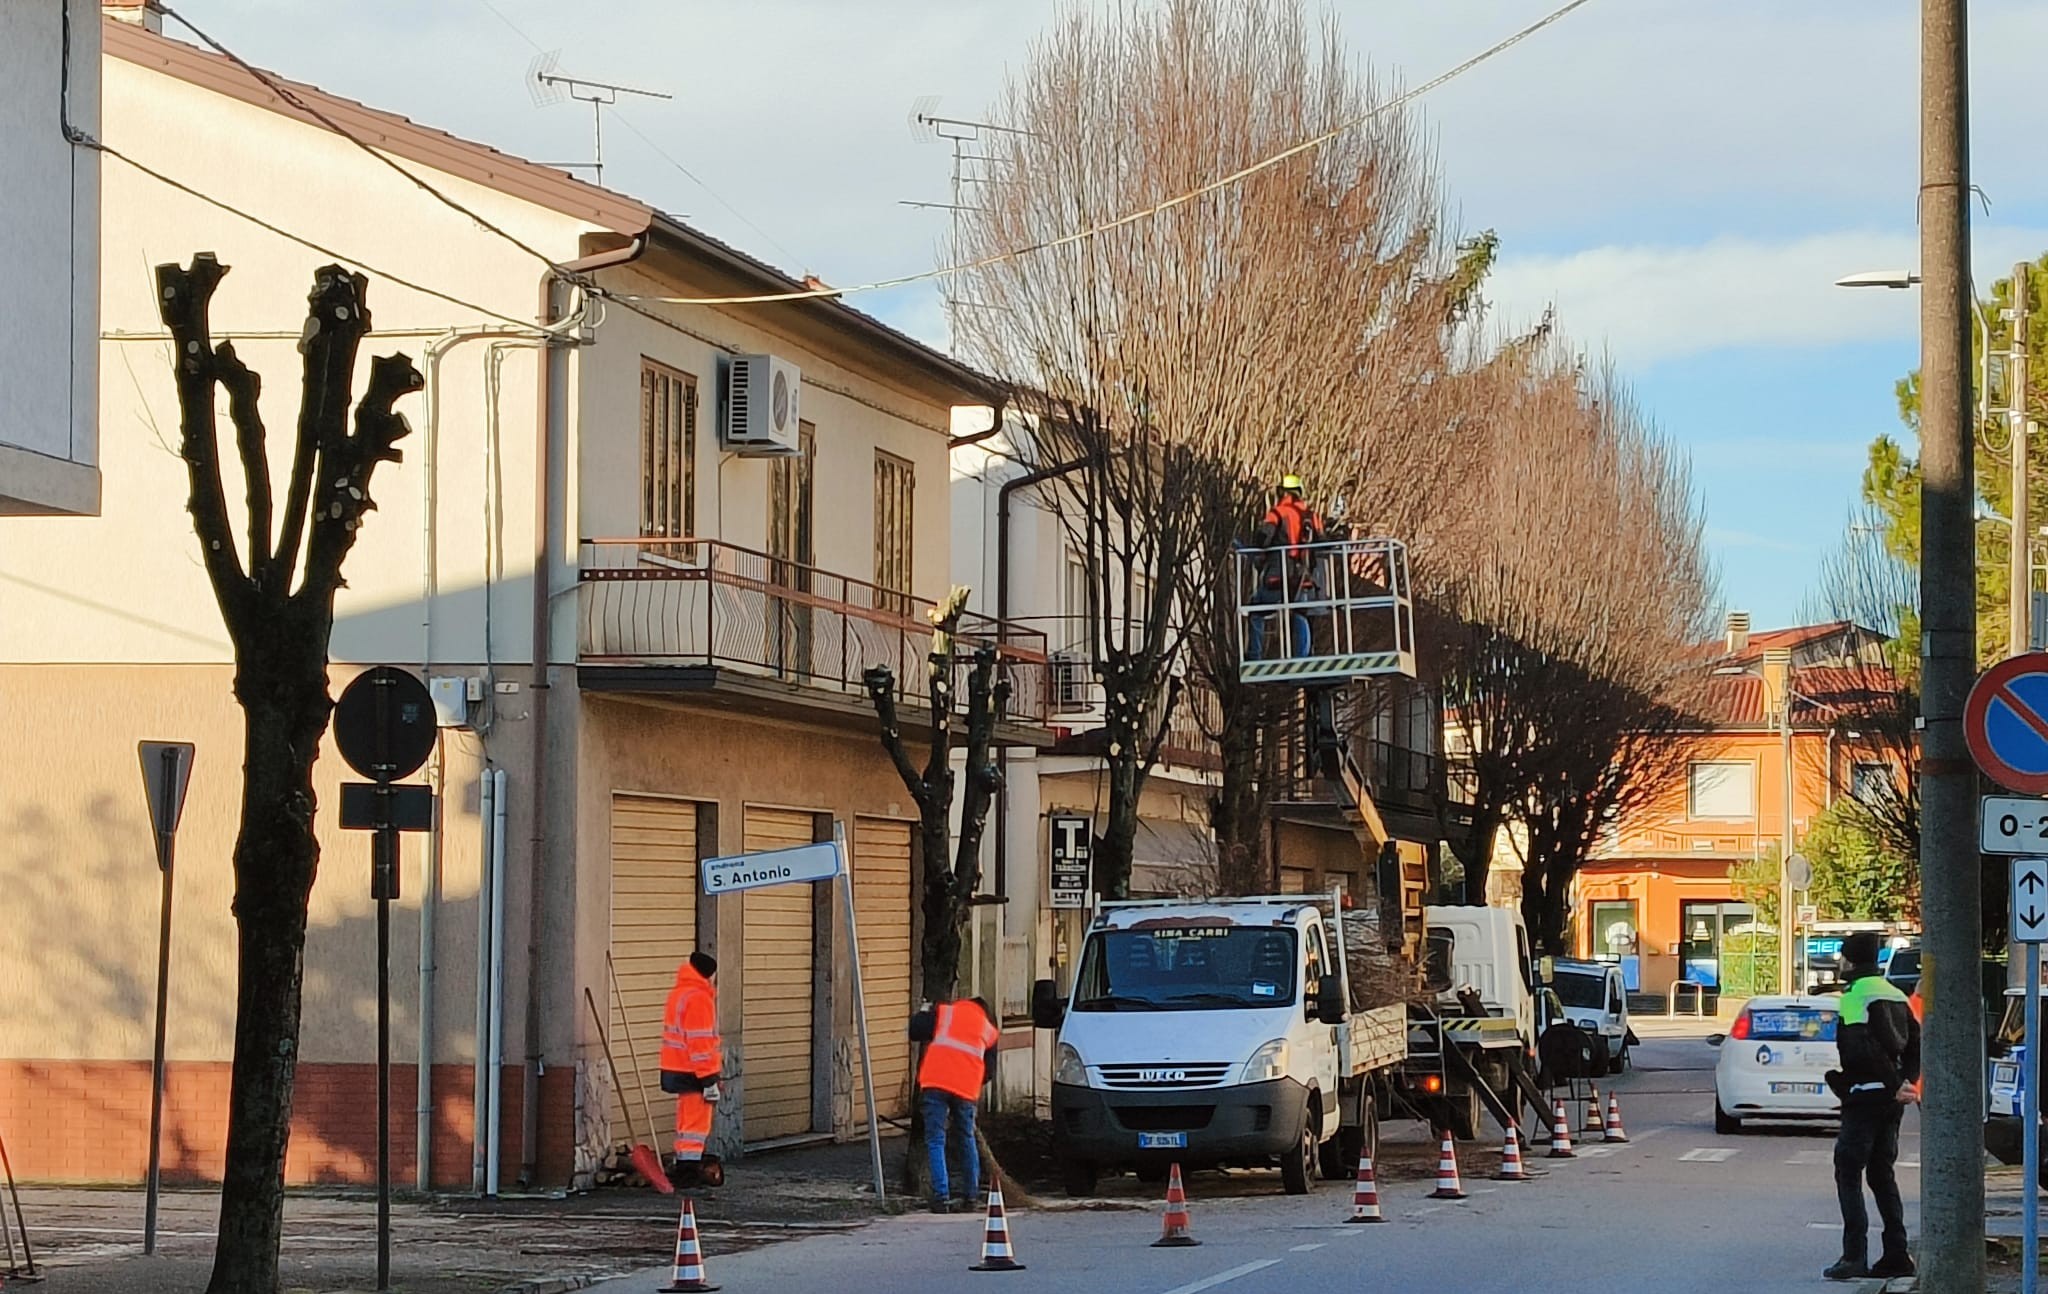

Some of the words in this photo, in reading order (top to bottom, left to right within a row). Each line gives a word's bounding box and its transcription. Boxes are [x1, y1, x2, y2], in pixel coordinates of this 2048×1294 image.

[1058, 820, 1083, 858] T
[713, 874, 727, 887] S.
[732, 865, 791, 884] Antonio
[1139, 1071, 1185, 1082] IVECO
